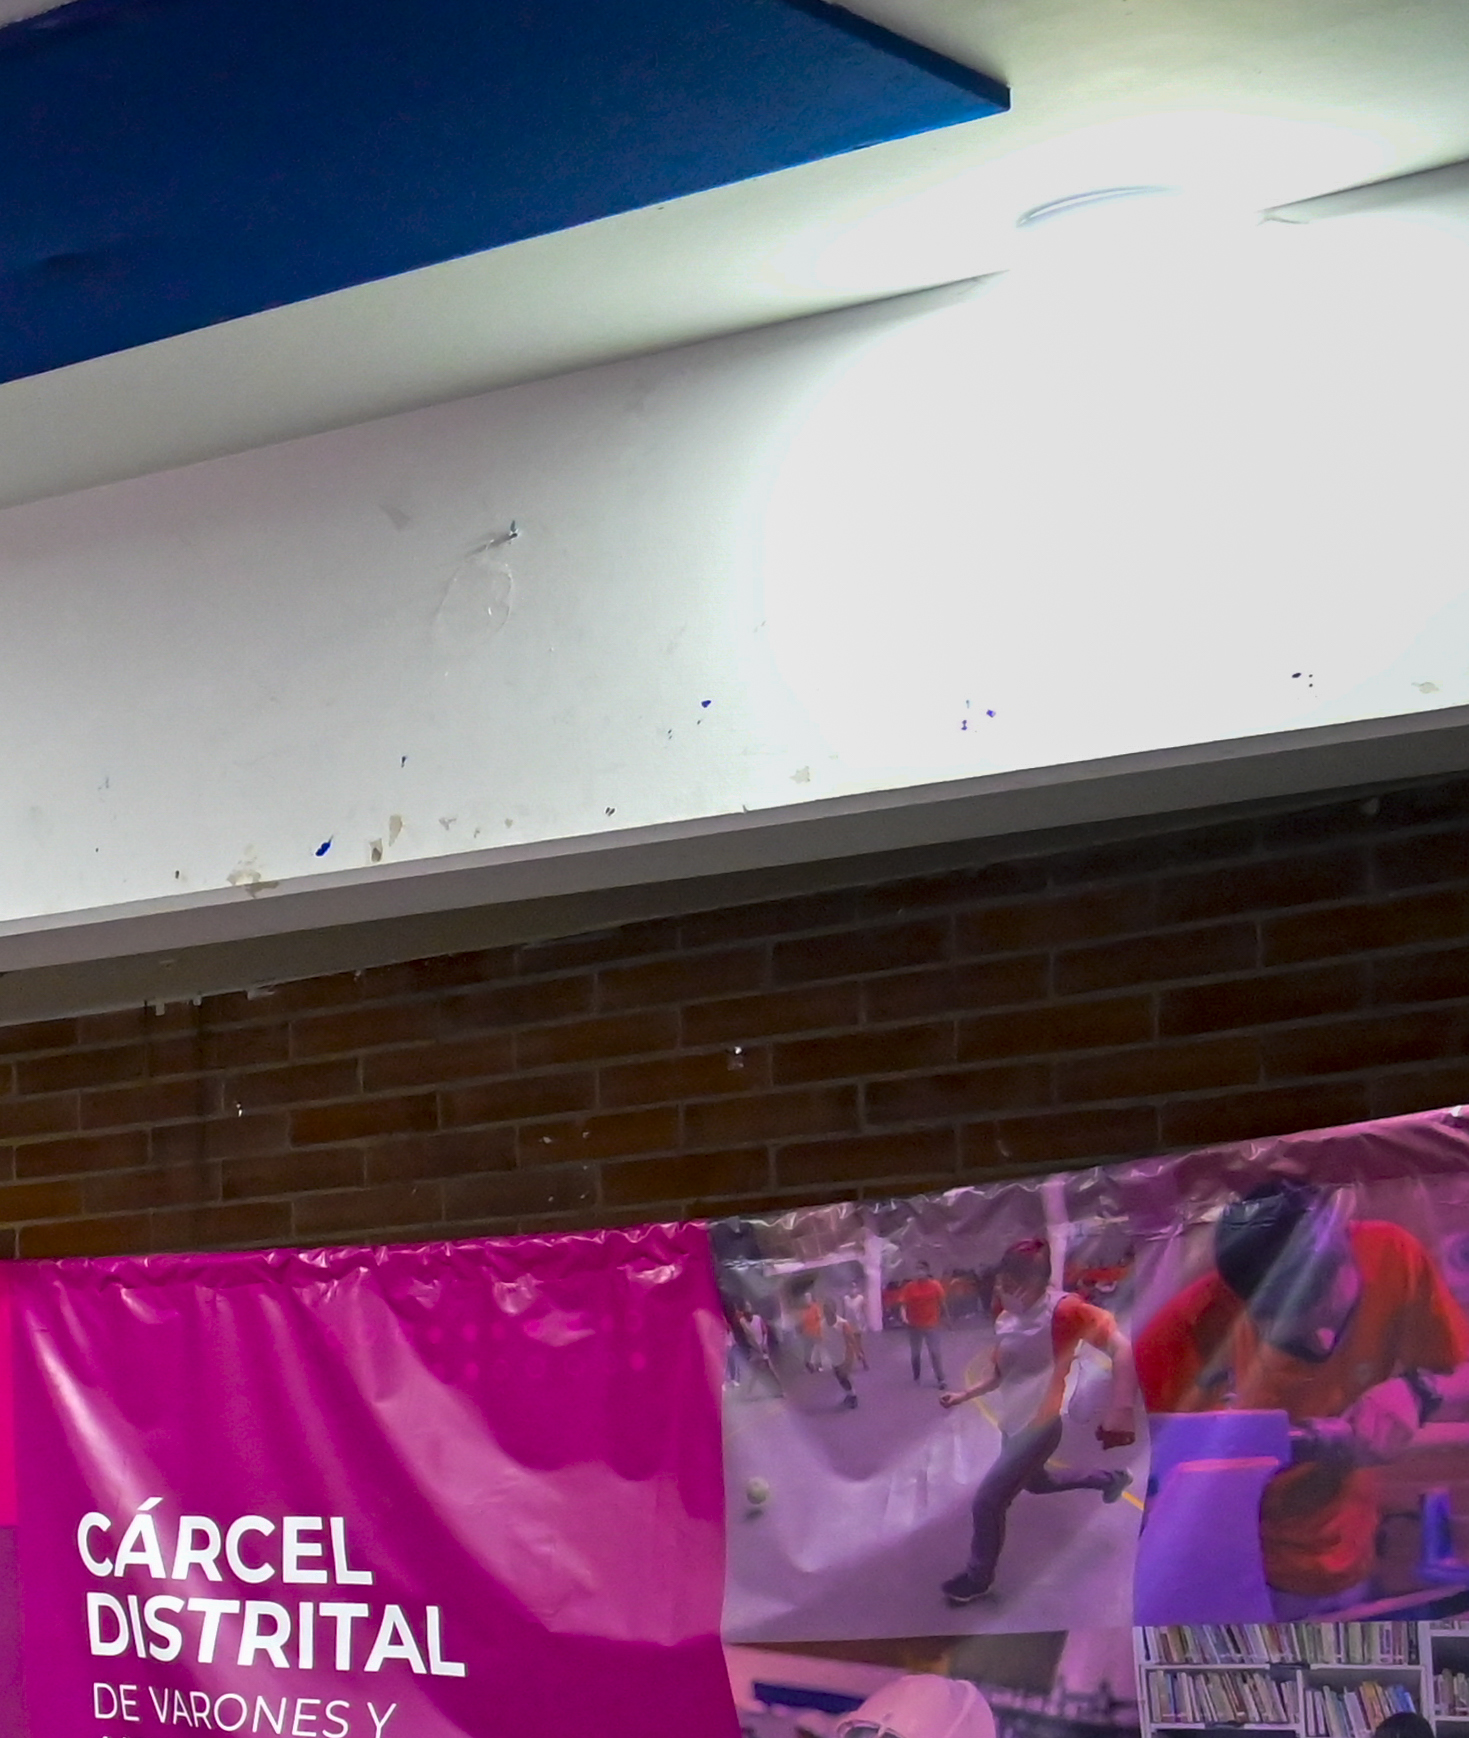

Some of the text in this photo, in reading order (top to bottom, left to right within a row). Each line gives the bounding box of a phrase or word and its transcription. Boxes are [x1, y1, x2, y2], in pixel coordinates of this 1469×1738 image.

[76, 1496, 374, 1586] CÁRCEL
[85, 1591, 467, 1678] DISTRITAL
[92, 1681, 141, 1722] DE
